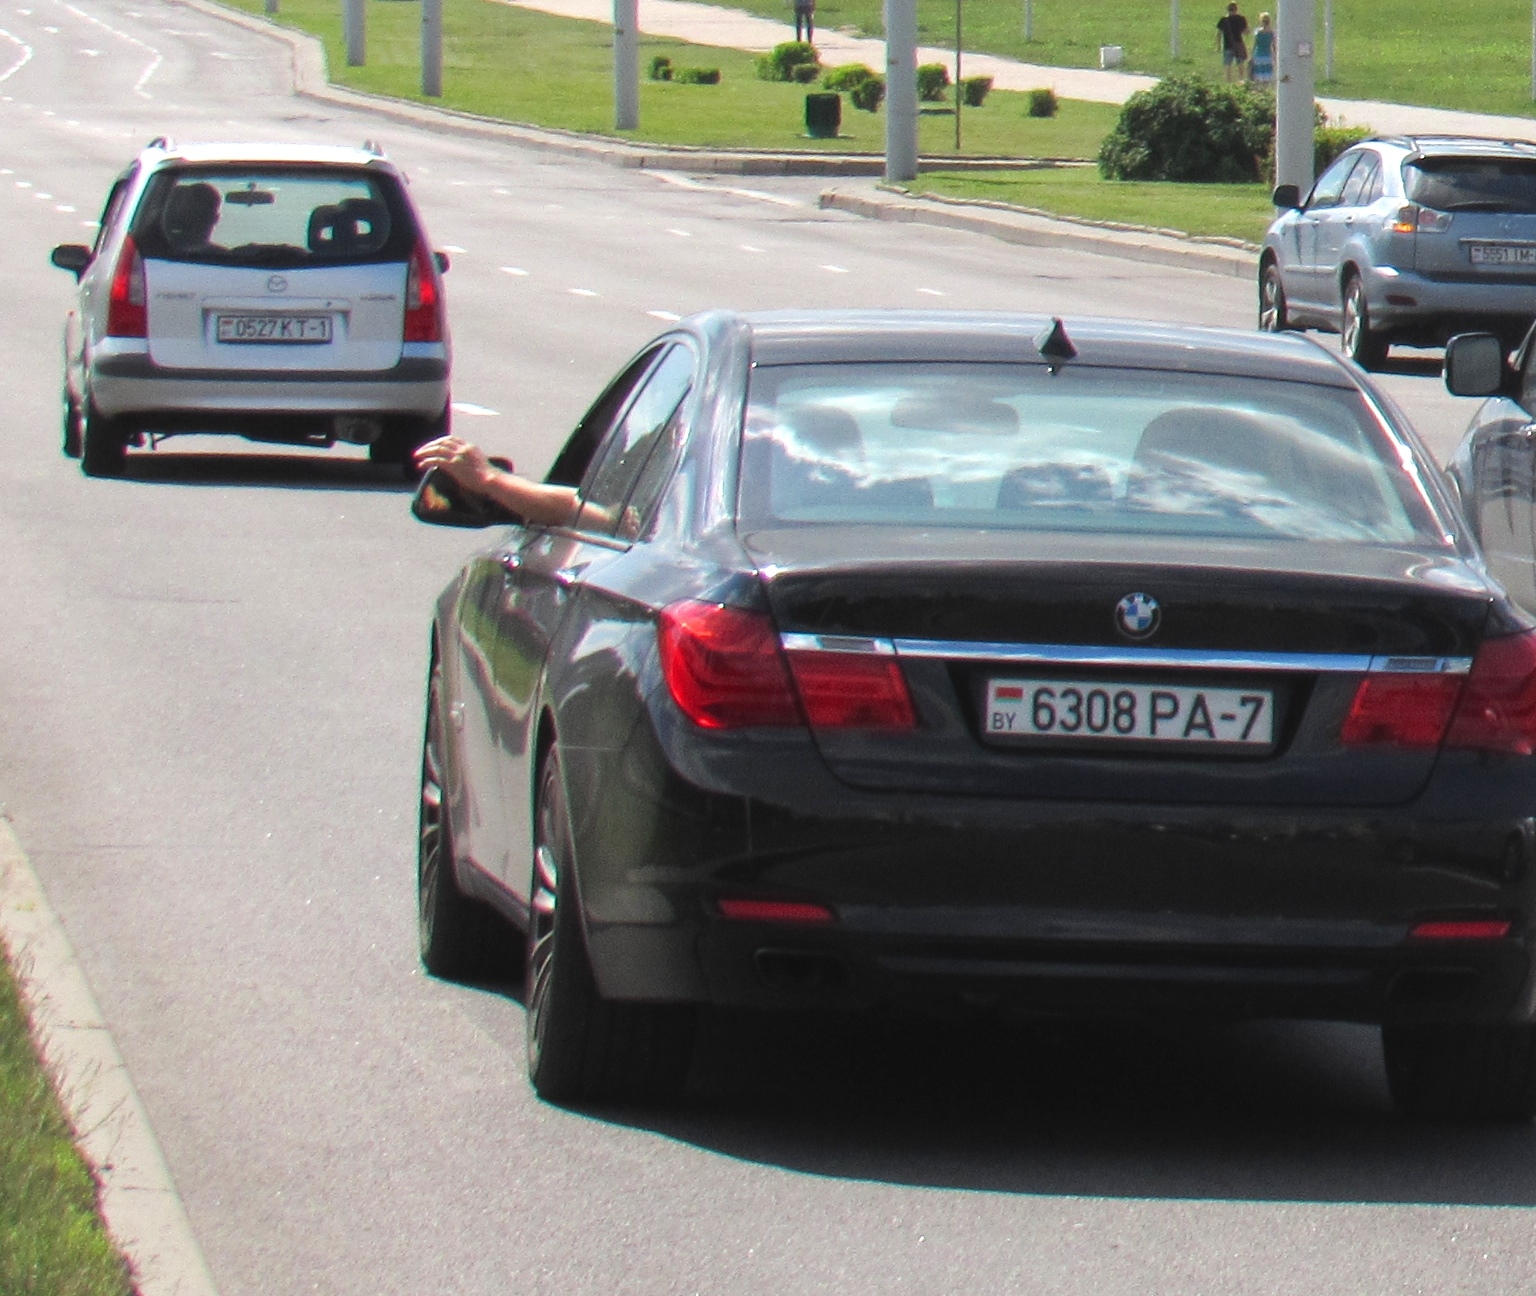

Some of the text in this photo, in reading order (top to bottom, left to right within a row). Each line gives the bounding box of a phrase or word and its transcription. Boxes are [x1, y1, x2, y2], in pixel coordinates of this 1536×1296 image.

[236, 318, 278, 337] 0527
[992, 686, 1266, 741] BY 6308 PA-7
